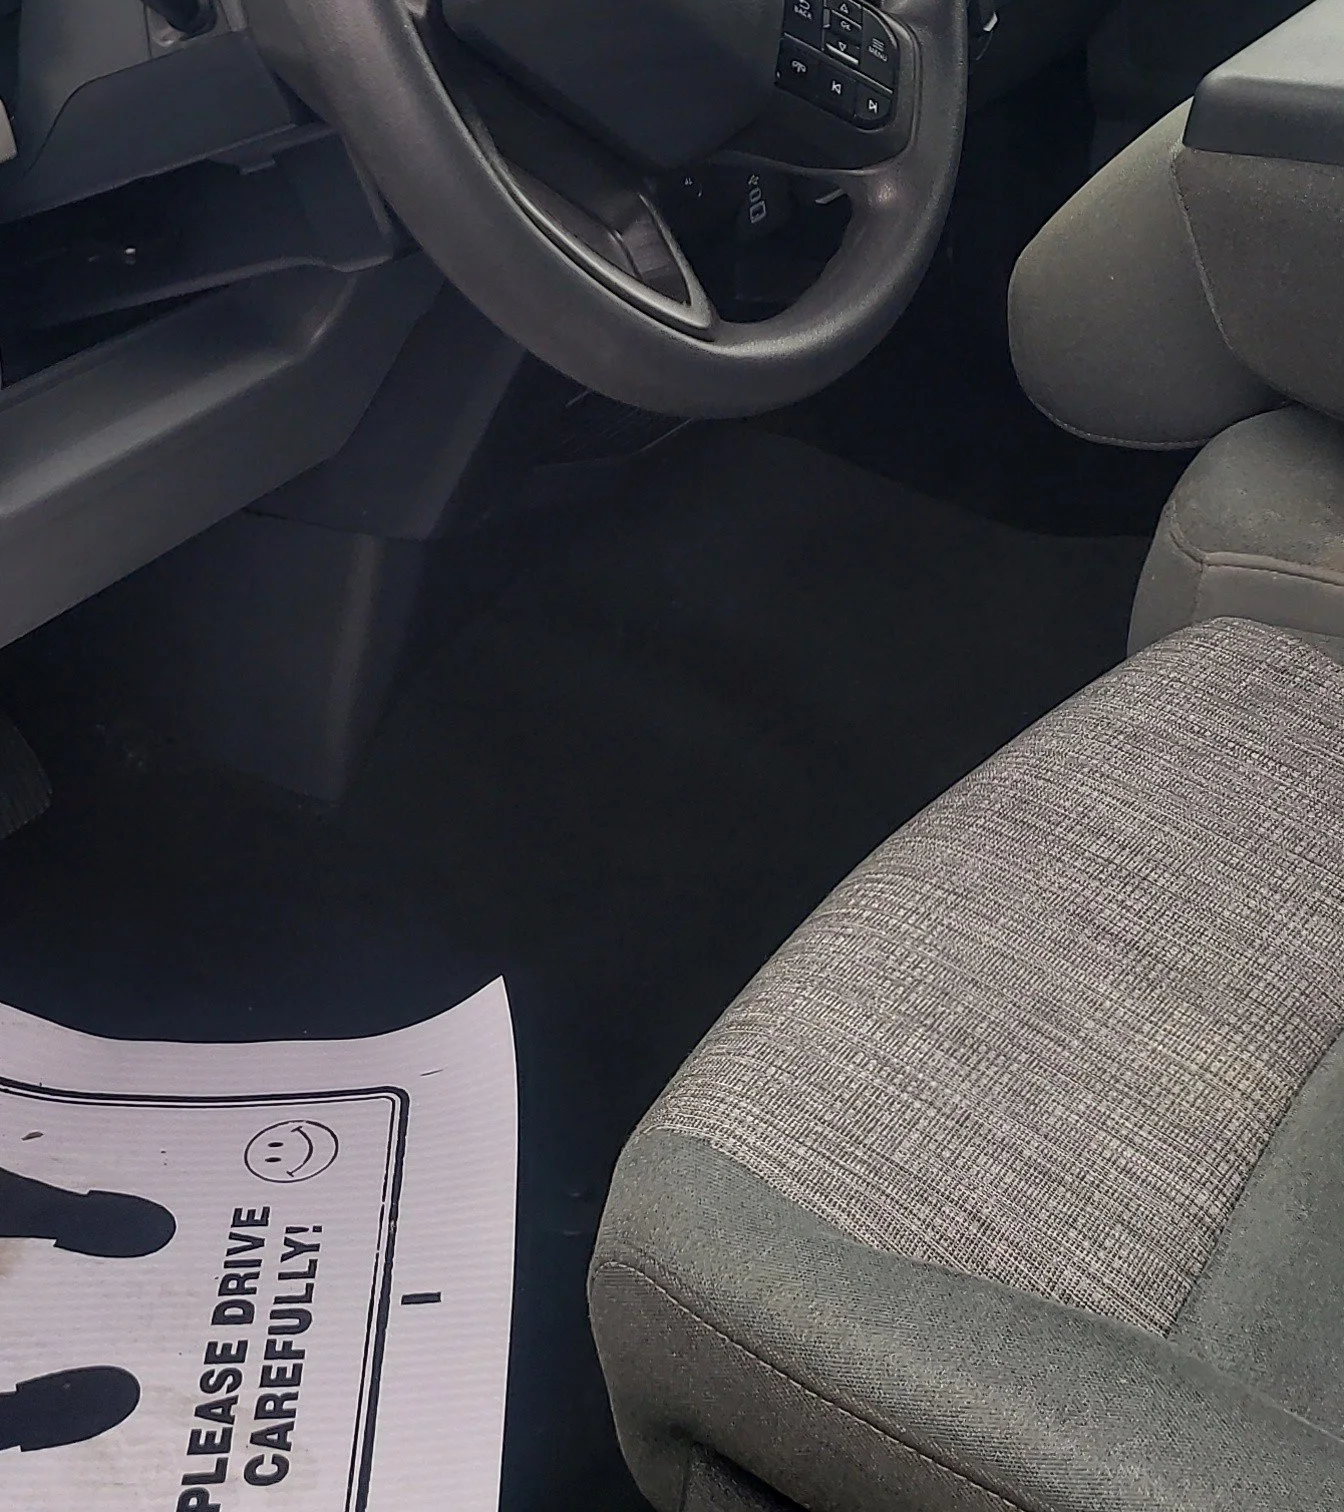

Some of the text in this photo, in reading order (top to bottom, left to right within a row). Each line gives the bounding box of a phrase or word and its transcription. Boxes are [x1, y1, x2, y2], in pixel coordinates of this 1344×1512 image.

[868, 45, 888, 63] MENU
[176, 1206, 270, 1512] PLEASE DRIVE
[243, 1224, 323, 1487] CAREFULLY!
